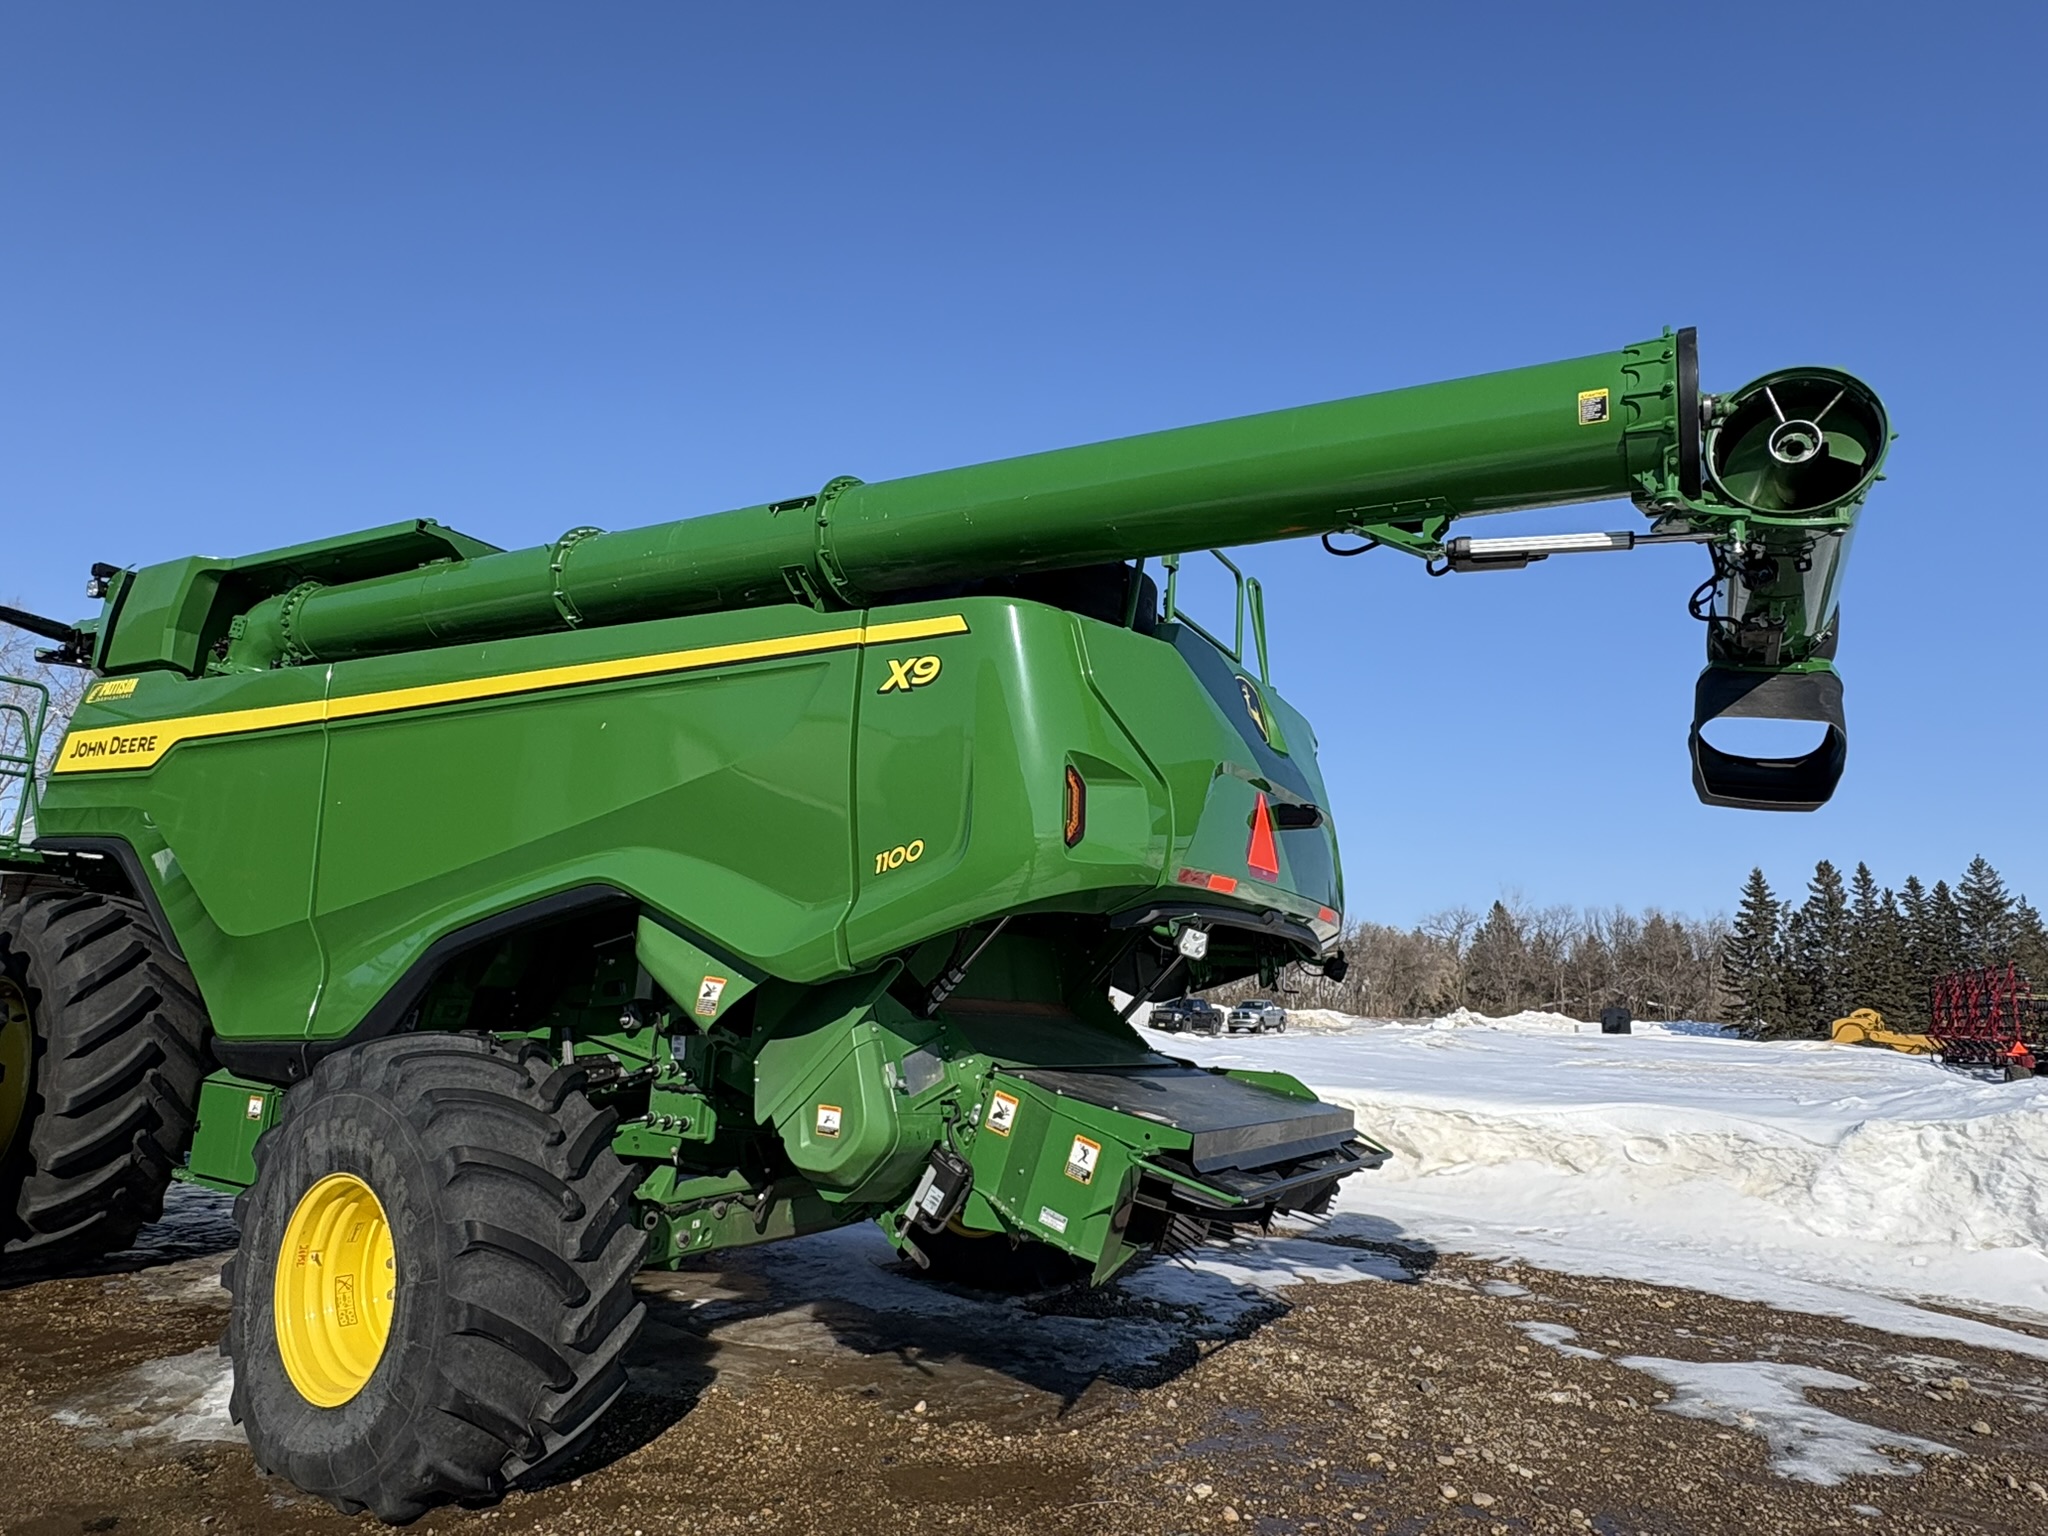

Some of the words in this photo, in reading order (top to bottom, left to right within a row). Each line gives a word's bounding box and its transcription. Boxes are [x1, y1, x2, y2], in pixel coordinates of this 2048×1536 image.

[877, 655, 943, 694] X9
[69, 740, 108, 759] JOHN
[109, 735, 158, 755] DEERE
[874, 838, 926, 876] 1100
